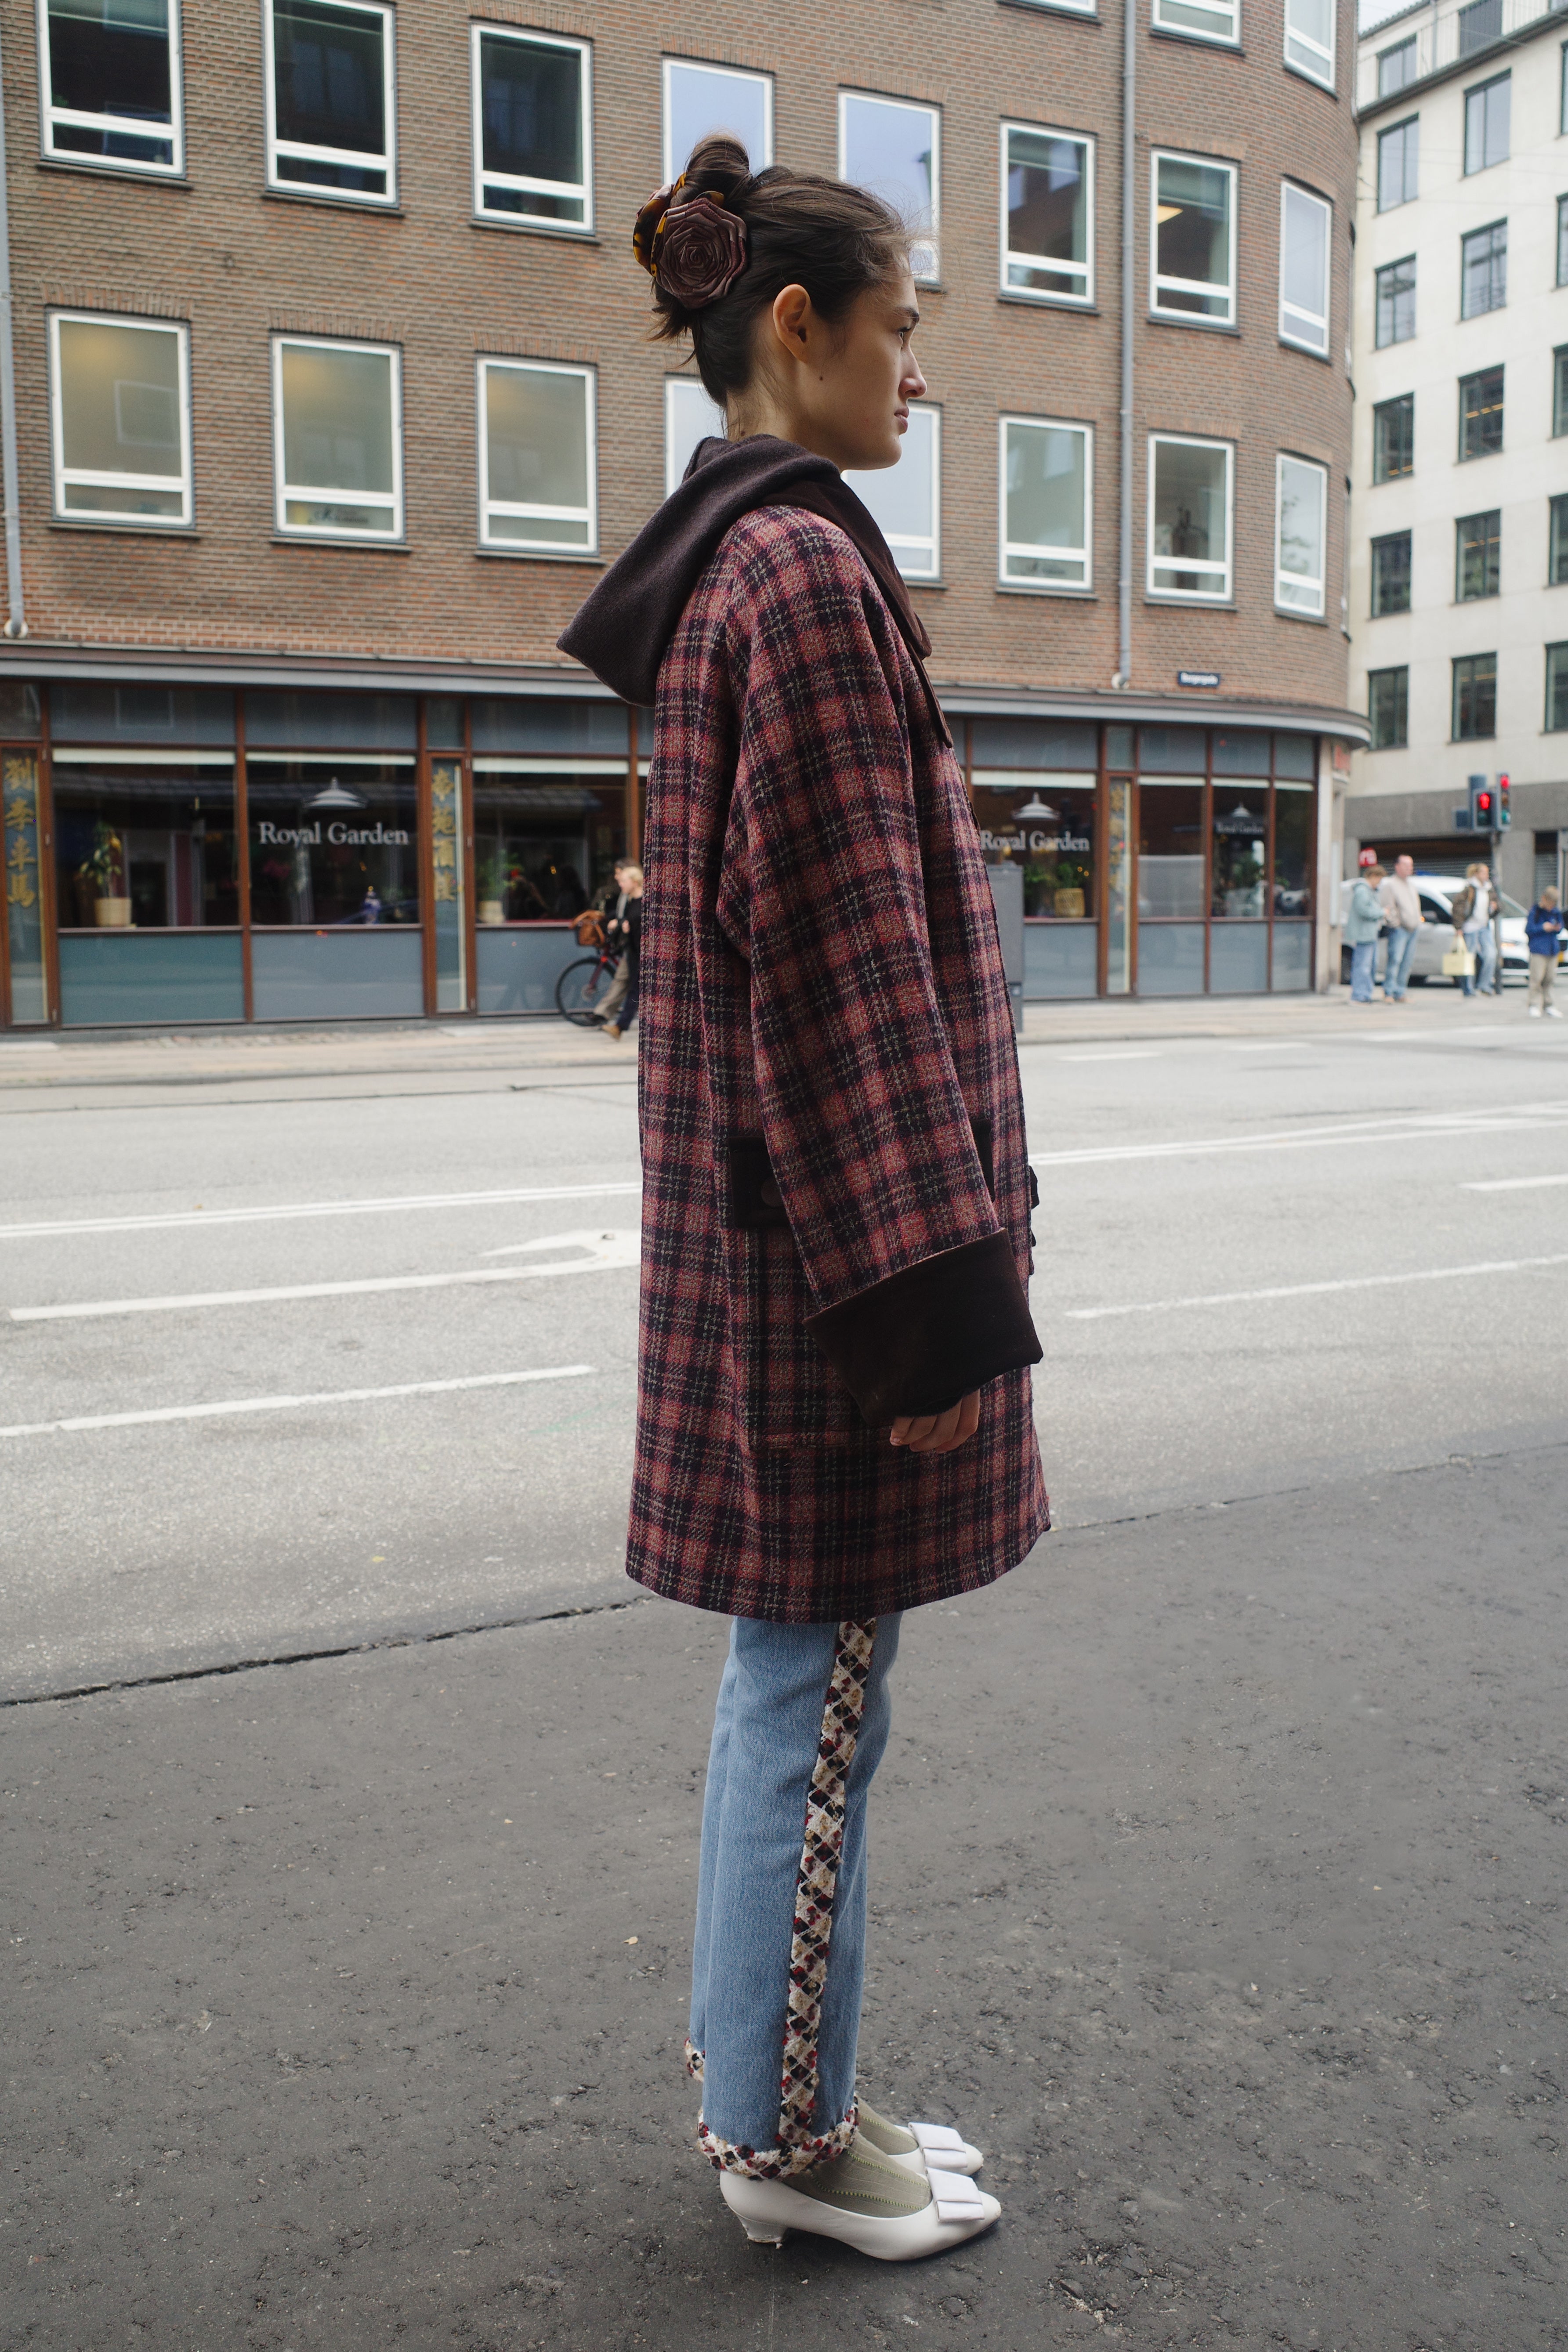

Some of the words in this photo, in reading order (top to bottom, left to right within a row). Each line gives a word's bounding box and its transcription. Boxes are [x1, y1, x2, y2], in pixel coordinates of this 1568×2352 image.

[258, 821, 322, 849] Royal
[328, 821, 409, 845] Garden
[980, 829, 1026, 853] Royal
[1029, 830, 1090, 851] Garden
